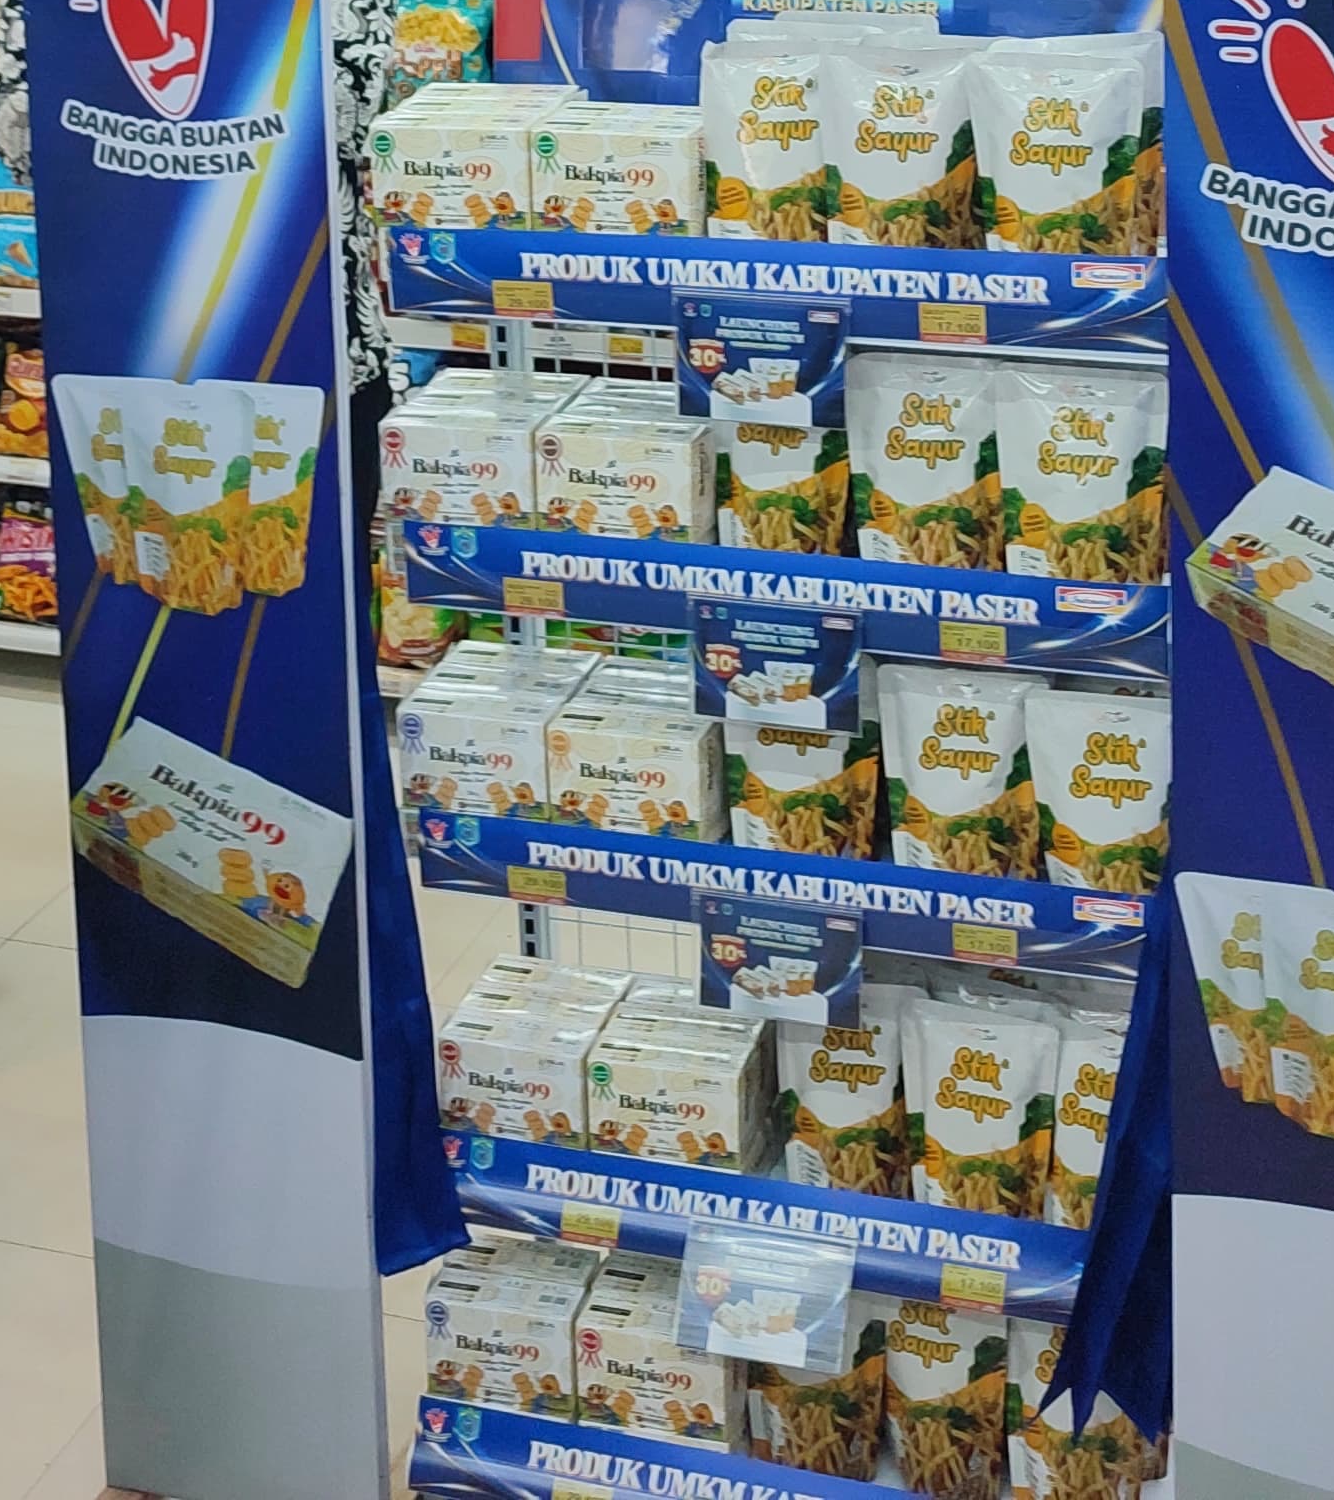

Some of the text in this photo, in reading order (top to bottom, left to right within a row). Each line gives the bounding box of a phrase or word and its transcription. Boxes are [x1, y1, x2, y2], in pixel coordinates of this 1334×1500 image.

[66, 103, 286, 148] BANGGA BUATAN
[737, 110, 819, 150] Sayur
[1023, 96, 1083, 137] Stik
[97, 142, 256, 176] INDONESIA
[854, 120, 939, 163] Sayur
[1010, 131, 1093, 176] Sayur
[519, 251, 1051, 305] PRODUK UMKM KABUPATEN PASER
[899, 392, 956, 432] Stik
[885, 426, 966, 469] Sayur
[1038, 441, 1120, 486] Sayur
[520, 550, 1040, 626] PRODUK UMKM KABUPATEN PASER
[933, 703, 987, 743] Stik
[919, 736, 1001, 780] Sayur
[1083, 731, 1142, 772] Stik
[147, 761, 243, 831] Bakpia
[242, 809, 287, 847] 99
[1070, 765, 1153, 809] Sayur
[527, 841, 1037, 929] PRODUK UMKM KABUPATEN PASER
[809, 1049, 886, 1093] Sayur
[951, 1046, 1004, 1091] Stik
[935, 1077, 1013, 1123] Sayur
[1058, 1093, 1110, 1143] Say
[526, 1163, 1022, 1270] PRODUK UMKM KABUPATEN PASER
[887, 1320, 962, 1369] Sayur
[527, 1440, 646, 1490] PRODUK
[647, 1468, 748, 1500] UMKM
